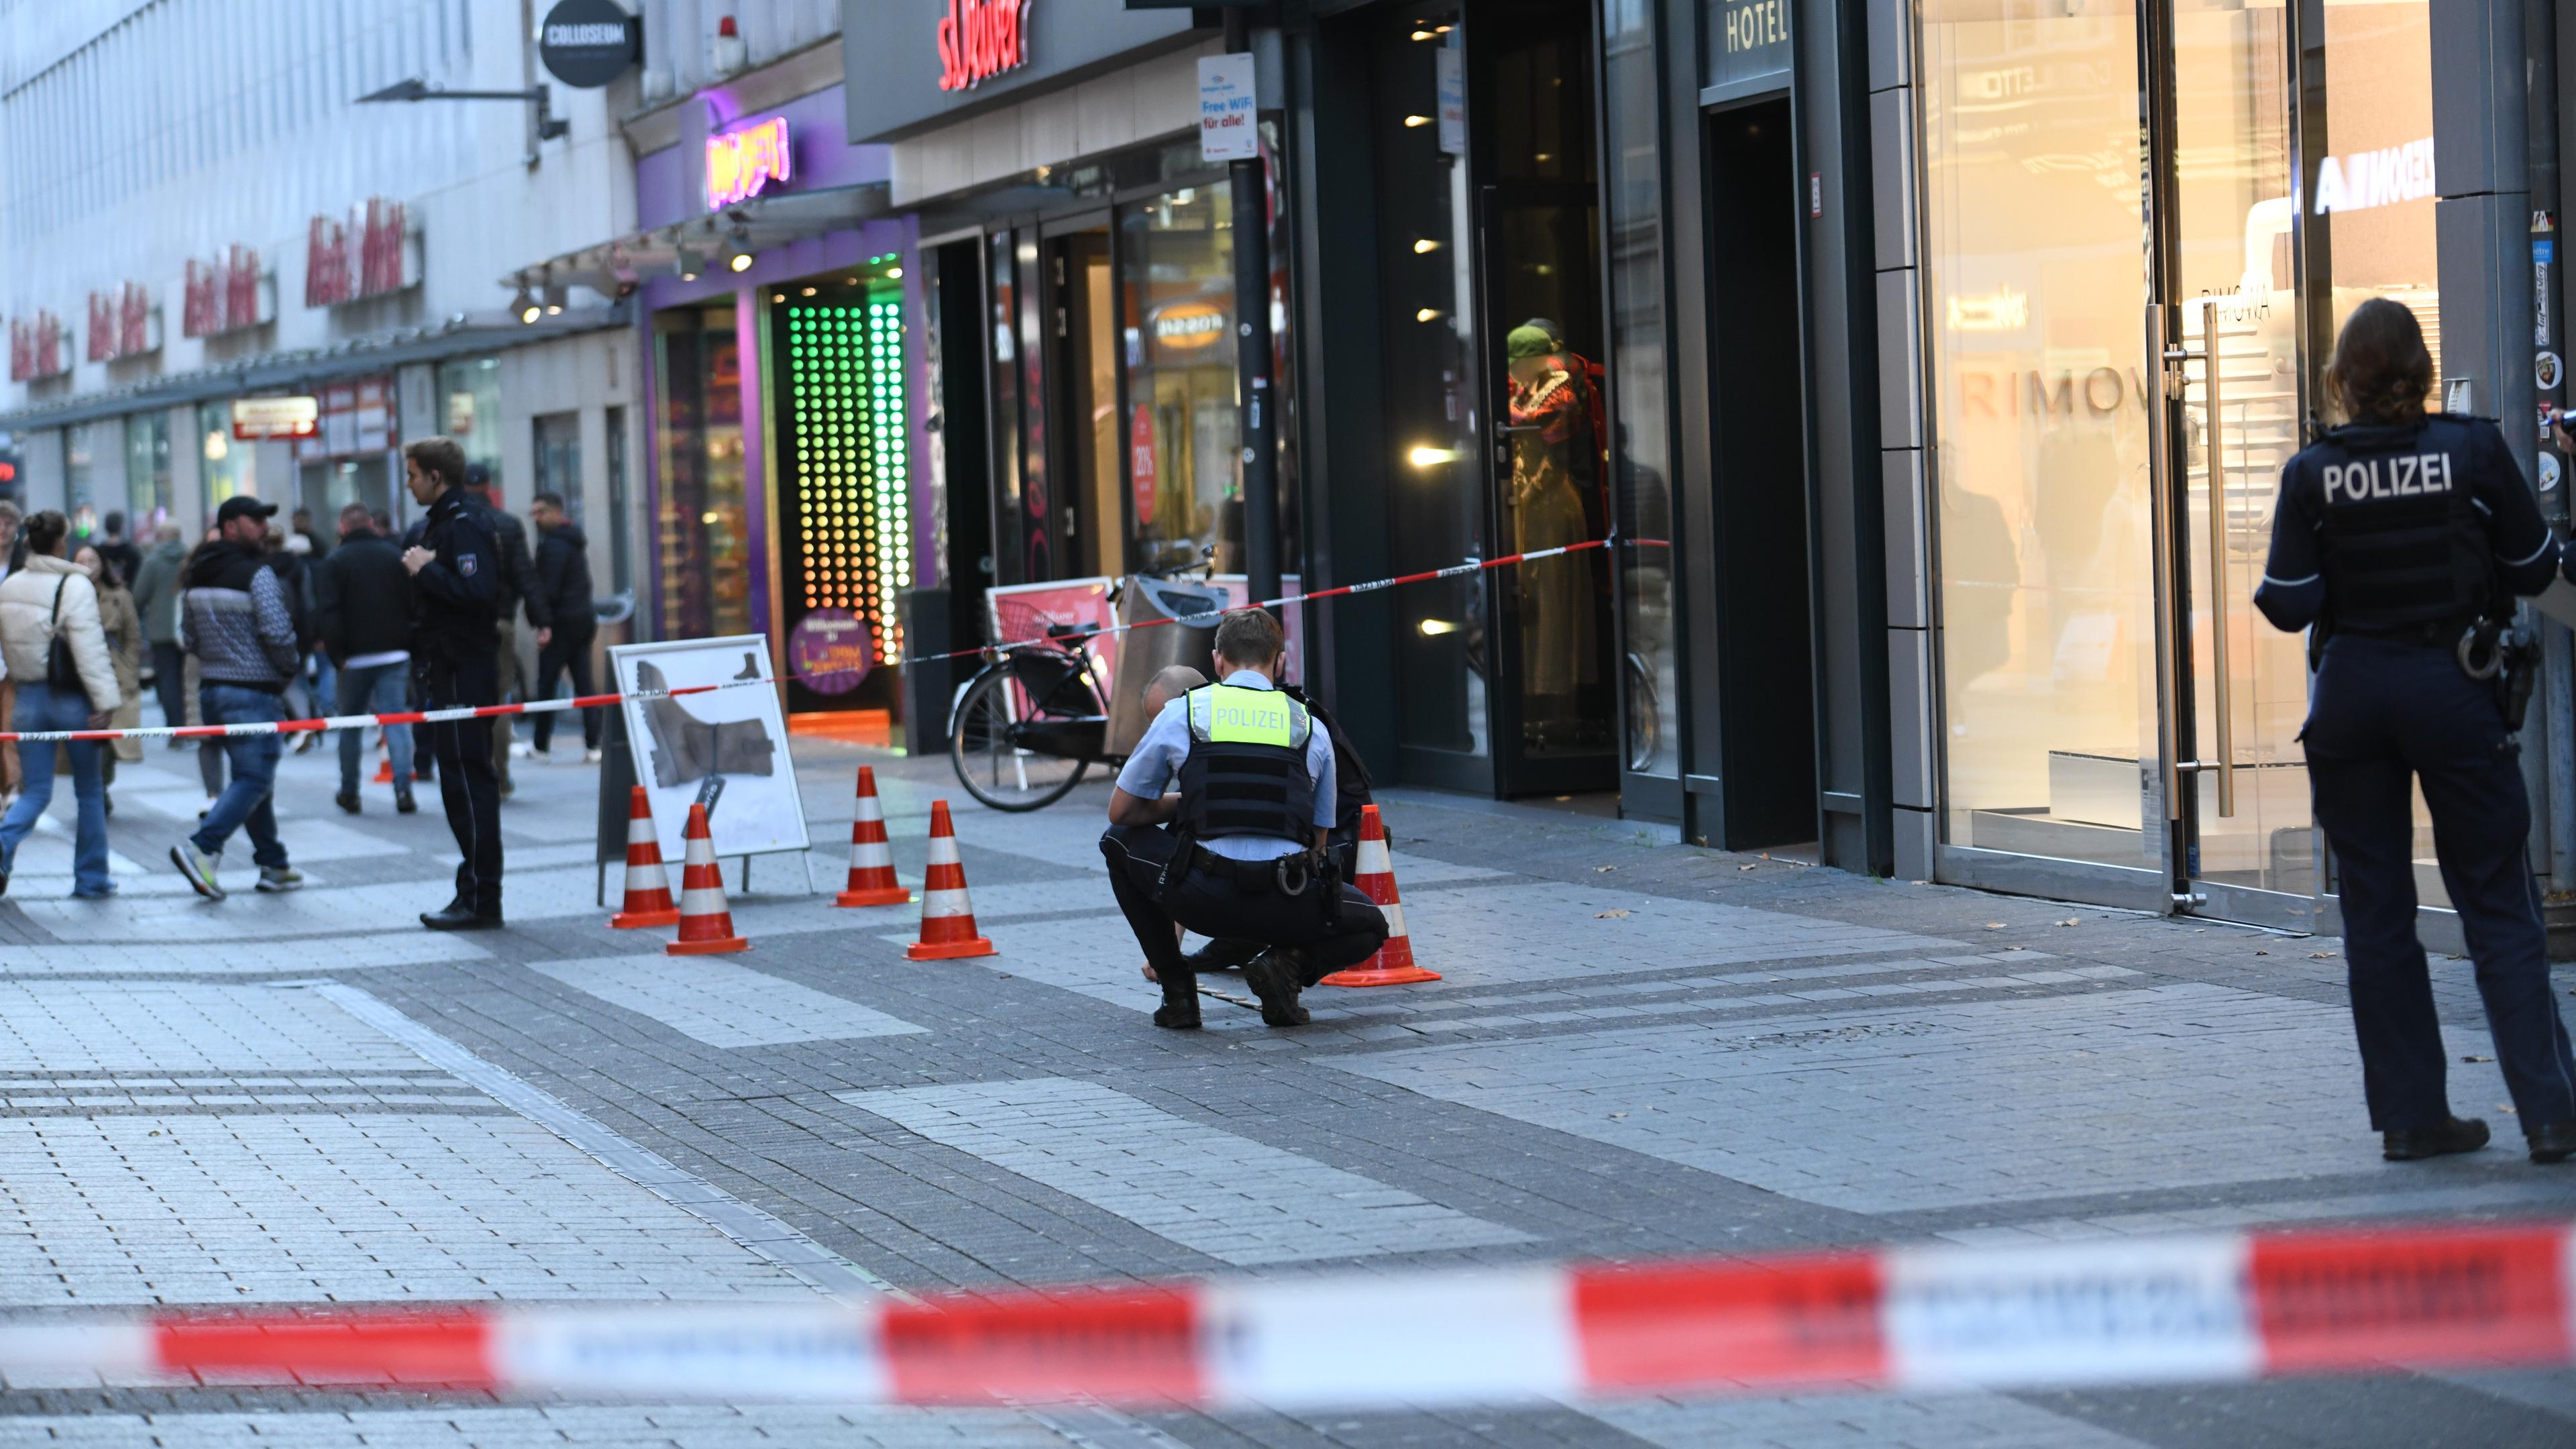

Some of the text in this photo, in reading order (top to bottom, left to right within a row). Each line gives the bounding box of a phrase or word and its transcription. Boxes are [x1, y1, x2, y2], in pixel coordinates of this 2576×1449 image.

[547, 23, 625, 46] COLLOSEUM
[1727, 0, 1788, 53] HOTEL
[1202, 97, 1252, 113] Free WiFi
[1203, 114, 1244, 129] für alle!
[2202, 284, 2271, 324] RIMOWA
[1961, 366, 2149, 417] RIMO
[2322, 451, 2453, 504] POLIZEI
[1216, 708, 1285, 730] POLIZEI
